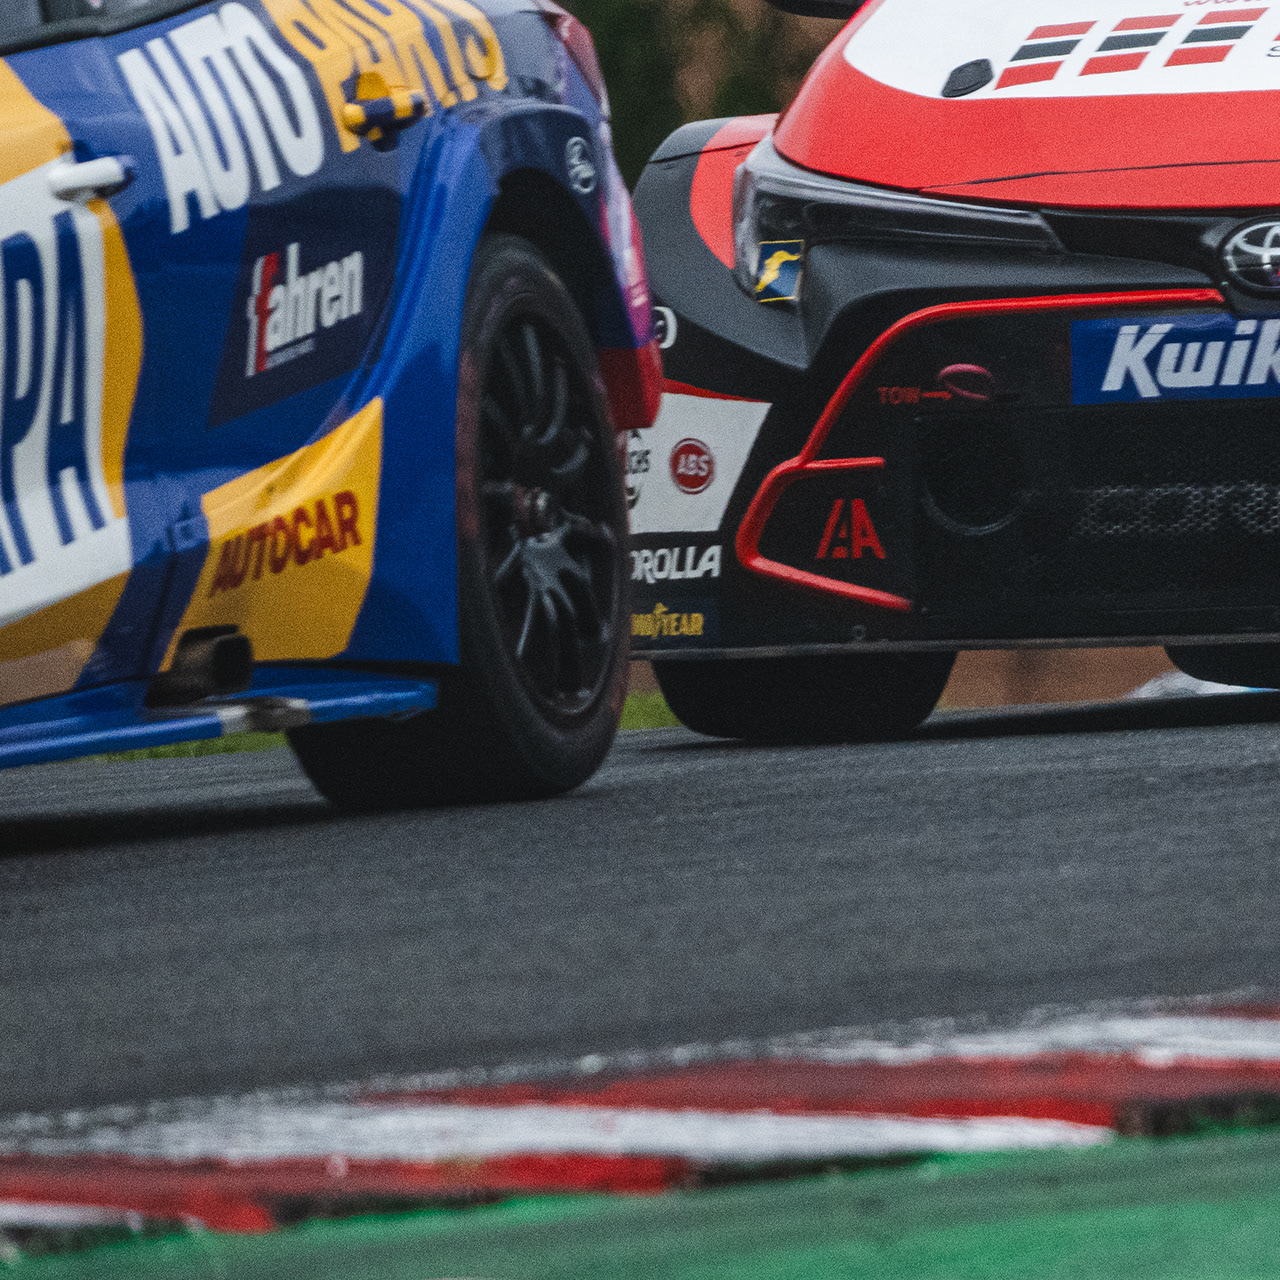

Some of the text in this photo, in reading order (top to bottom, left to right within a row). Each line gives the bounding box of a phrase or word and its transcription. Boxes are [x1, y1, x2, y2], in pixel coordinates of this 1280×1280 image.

[118, 2, 324, 234] AUTO
[245, 242, 364, 379] fahren
[0, 208, 107, 578] PA
[878, 386, 920, 405] TOW
[208, 489, 364, 598] AUTOCAR
[630, 544, 723, 584] ROLLA
